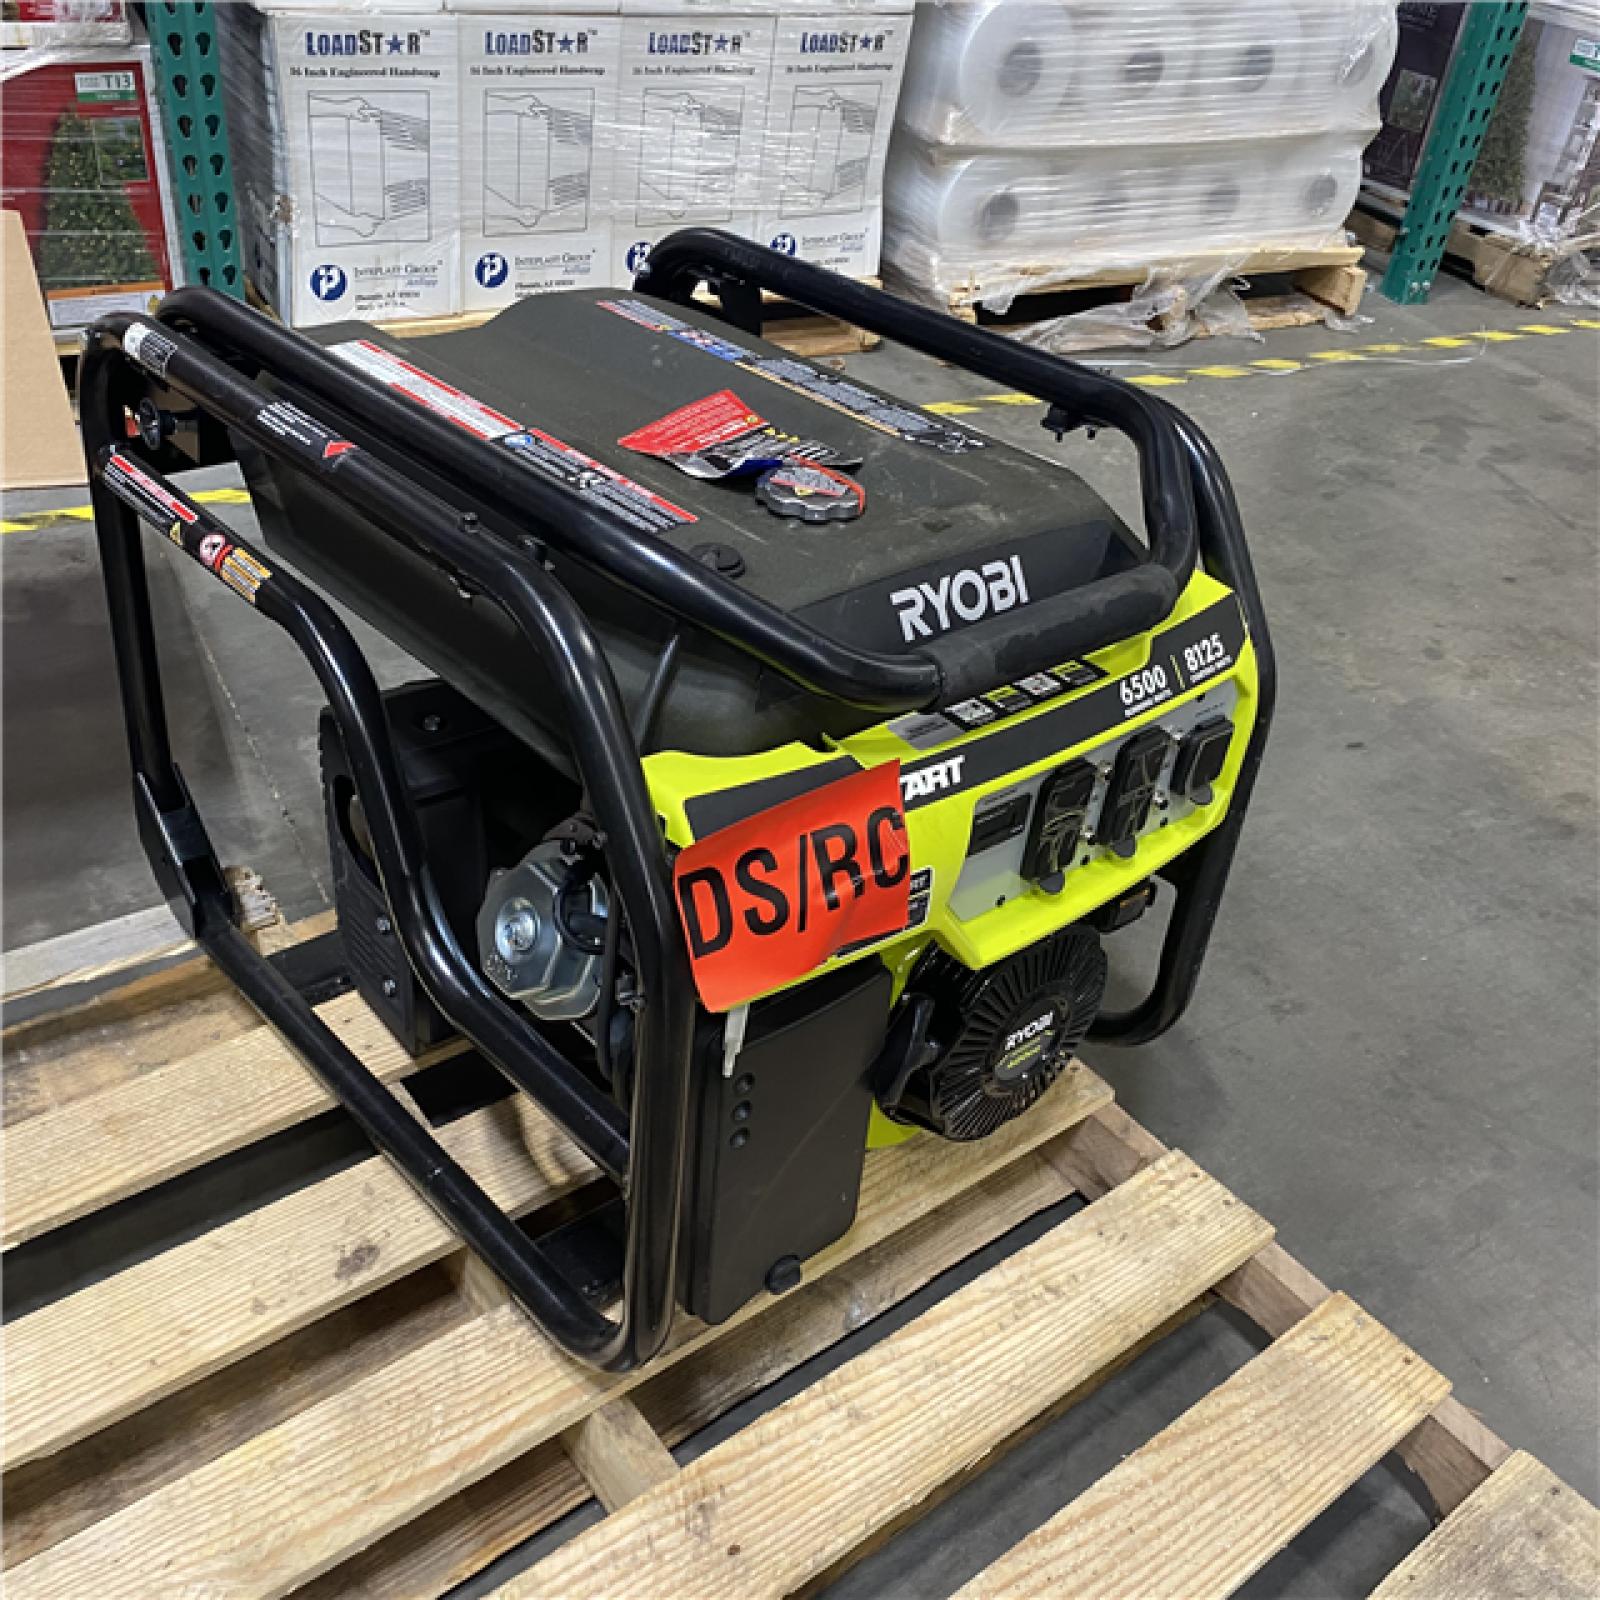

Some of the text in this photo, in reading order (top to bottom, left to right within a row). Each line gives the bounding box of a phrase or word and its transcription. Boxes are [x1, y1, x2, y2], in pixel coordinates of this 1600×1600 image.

[101, 74, 131, 89] T13
[890, 554, 1030, 643] RYOBI
[1184, 632, 1225, 672] 8125
[1119, 664, 1168, 706] 6500
[677, 806, 909, 961] DS/RC
